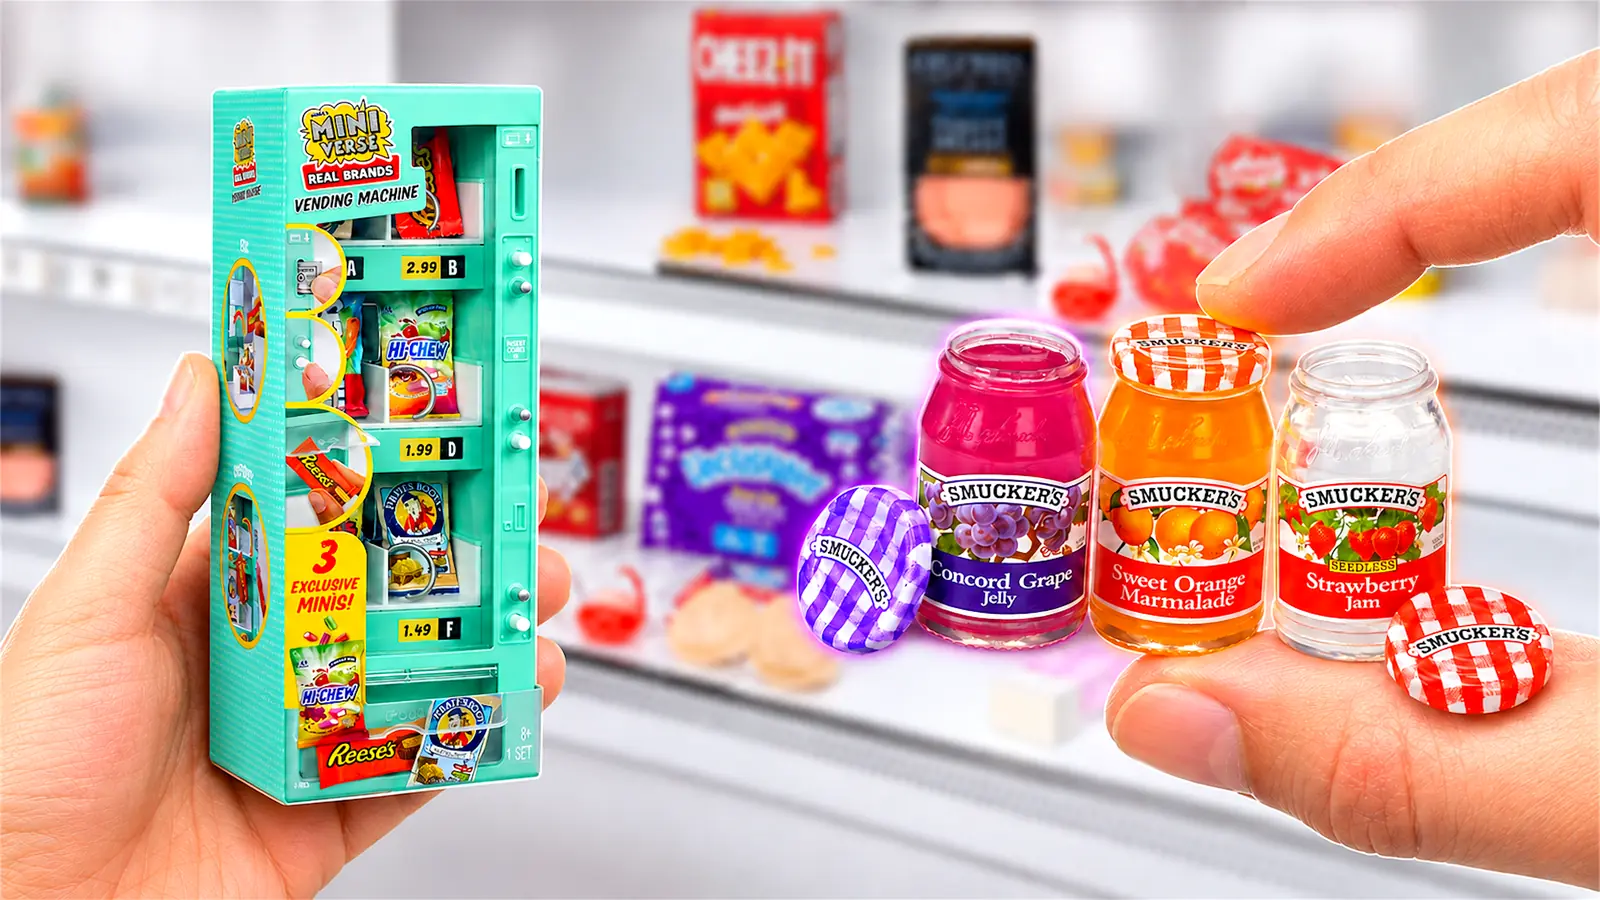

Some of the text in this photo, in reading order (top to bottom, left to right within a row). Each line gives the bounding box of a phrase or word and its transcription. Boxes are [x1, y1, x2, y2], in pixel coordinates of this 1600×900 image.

[310, 109, 381, 142] MINI
[319, 134, 379, 158] VERSE
[308, 165, 394, 185] REAL BRANDS
[294, 184, 420, 212] VENDING MACHINE
[347, 260, 357, 276] A
[406, 259, 458, 276] 2.99 B
[405, 441, 456, 458] 1.99 D
[948, 483, 1064, 506] SMUCKER'S
[1127, 486, 1243, 509] SMUCKER'S
[1305, 487, 1421, 509] SMUCKER'S
[312, 539, 338, 574] 3
[1331, 560, 1397, 573] SEEDLESS
[819, 538, 888, 608] SMUCKER'S
[931, 560, 1073, 590] Concord Grape
[1111, 563, 1246, 594] Sweet Orange
[1306, 572, 1420, 594] Strawberry
[290, 577, 360, 594] EXCLUSIVE
[981, 591, 1017, 608] Jelly
[1120, 584, 1235, 611] Marmalade
[1345, 595, 1381, 612] Jam
[403, 621, 454, 638] 1.49 F
[1416, 626, 1532, 656] SMUCKER'S
[521, 727, 532, 742] 8+
[328, 741, 397, 768] Reese's
[515, 745, 532, 761] SET
